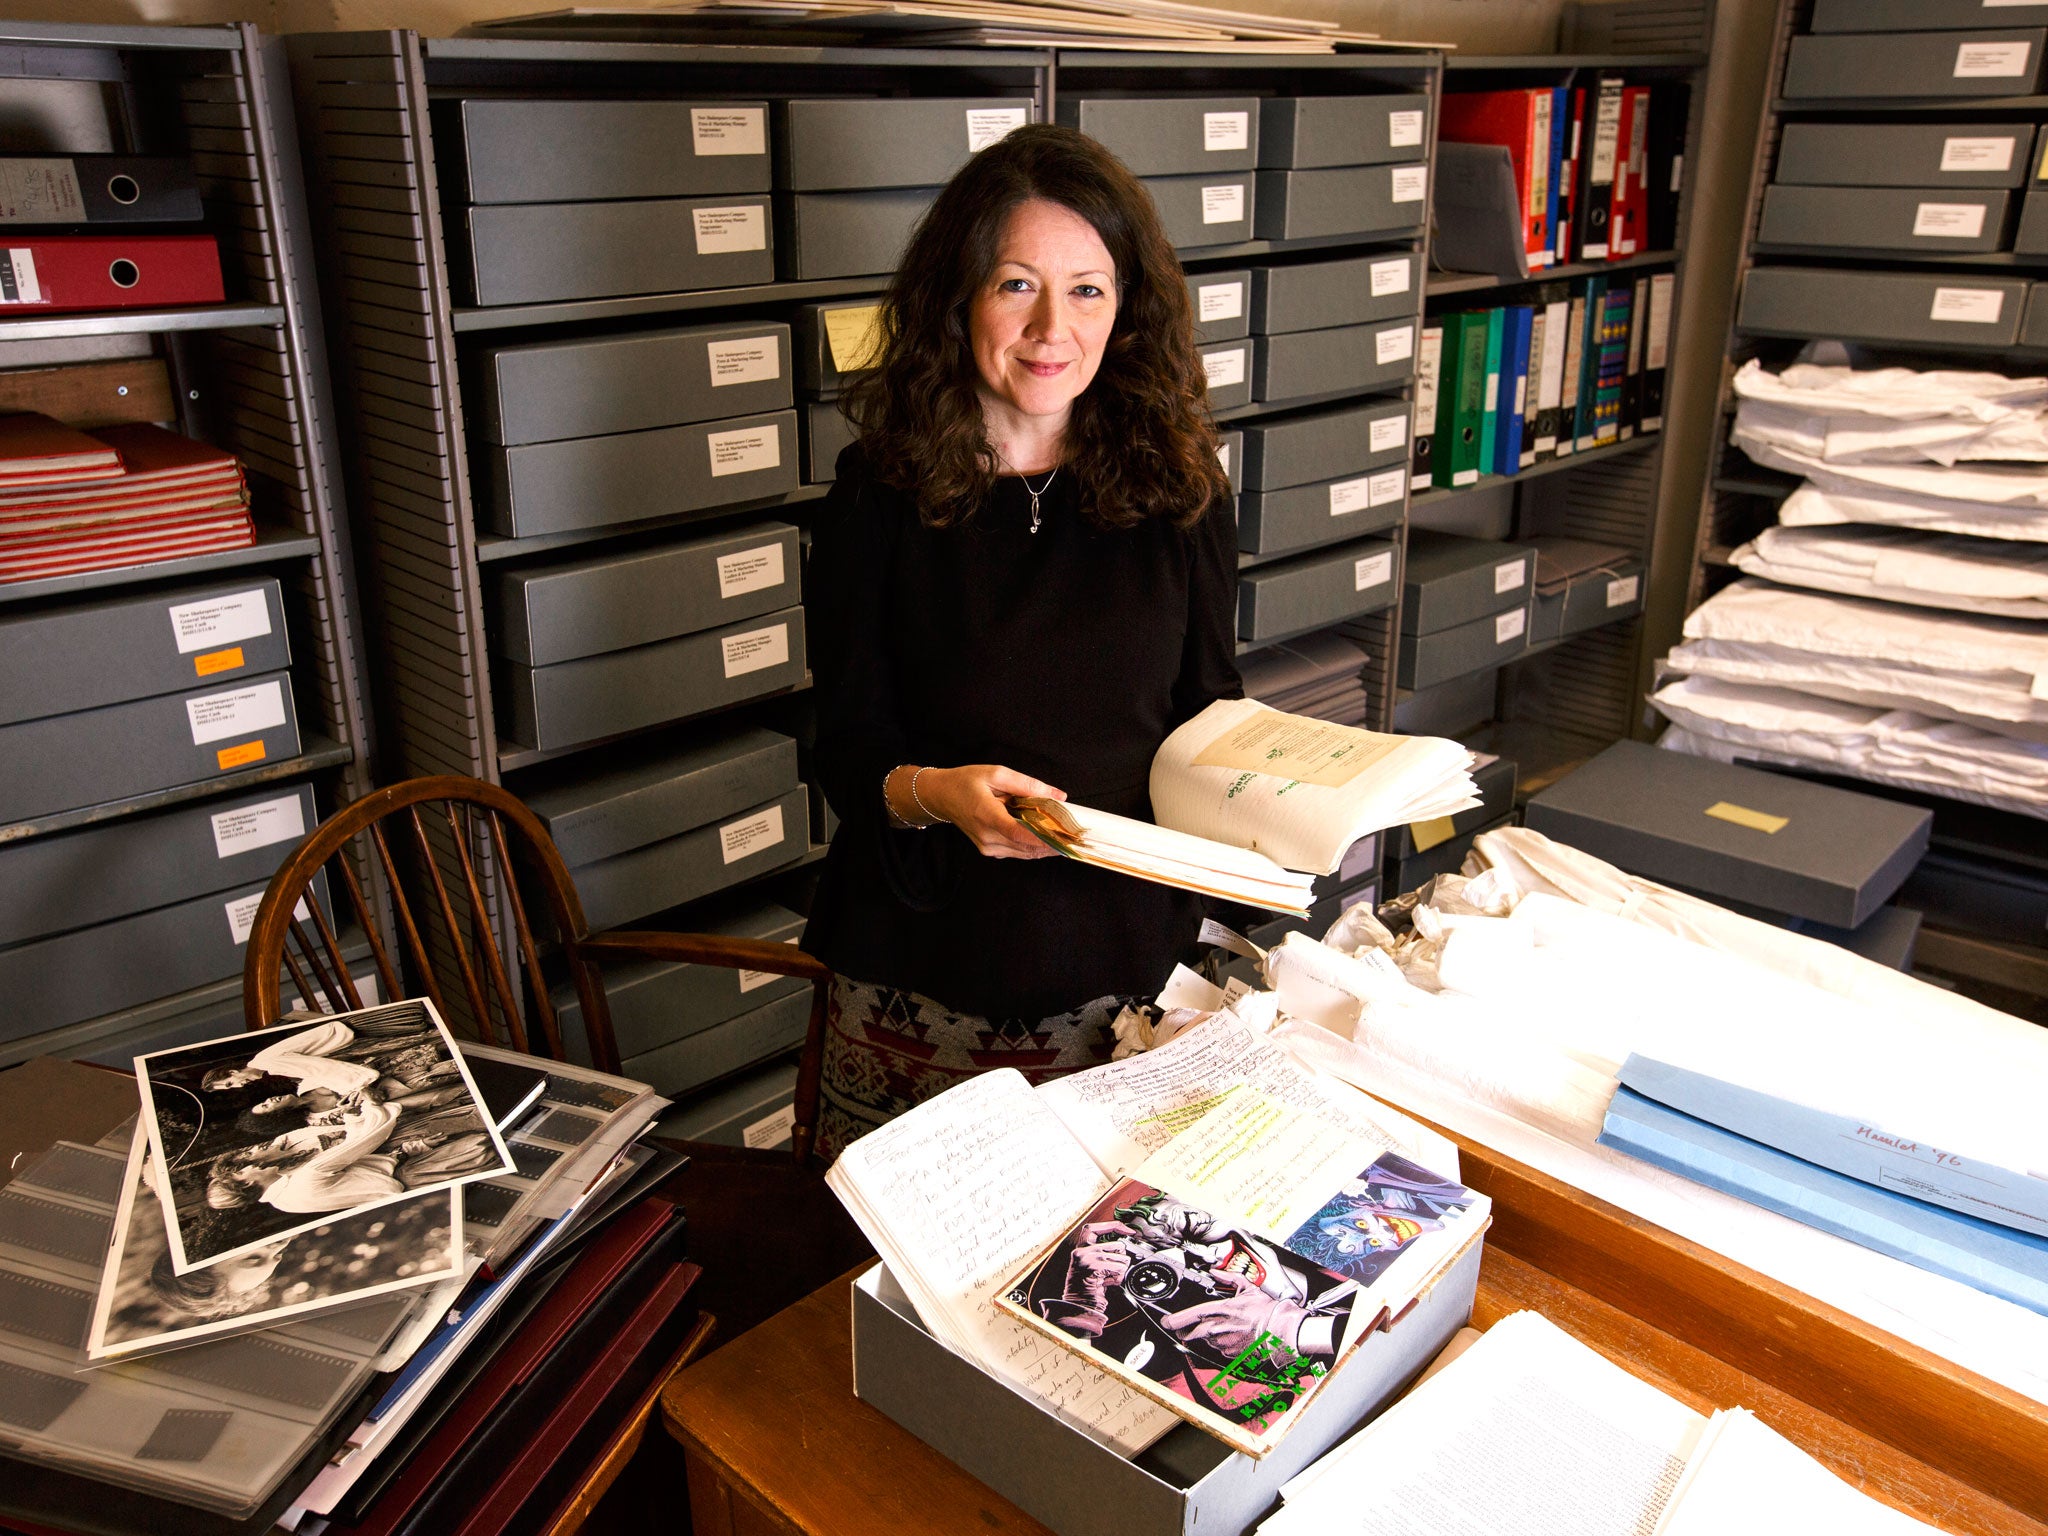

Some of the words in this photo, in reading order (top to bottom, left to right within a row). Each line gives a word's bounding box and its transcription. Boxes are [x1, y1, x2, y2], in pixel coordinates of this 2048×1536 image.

[1857, 1126, 1918, 1153] Hamlet
[1932, 1148, 1962, 1167] '96
[1213, 1335, 1284, 1398] BATMAN
[1228, 1345, 1296, 1406] THE
[1240, 1355, 1310, 1419] KILLING
[1258, 1364, 1328, 1429] JOKE
